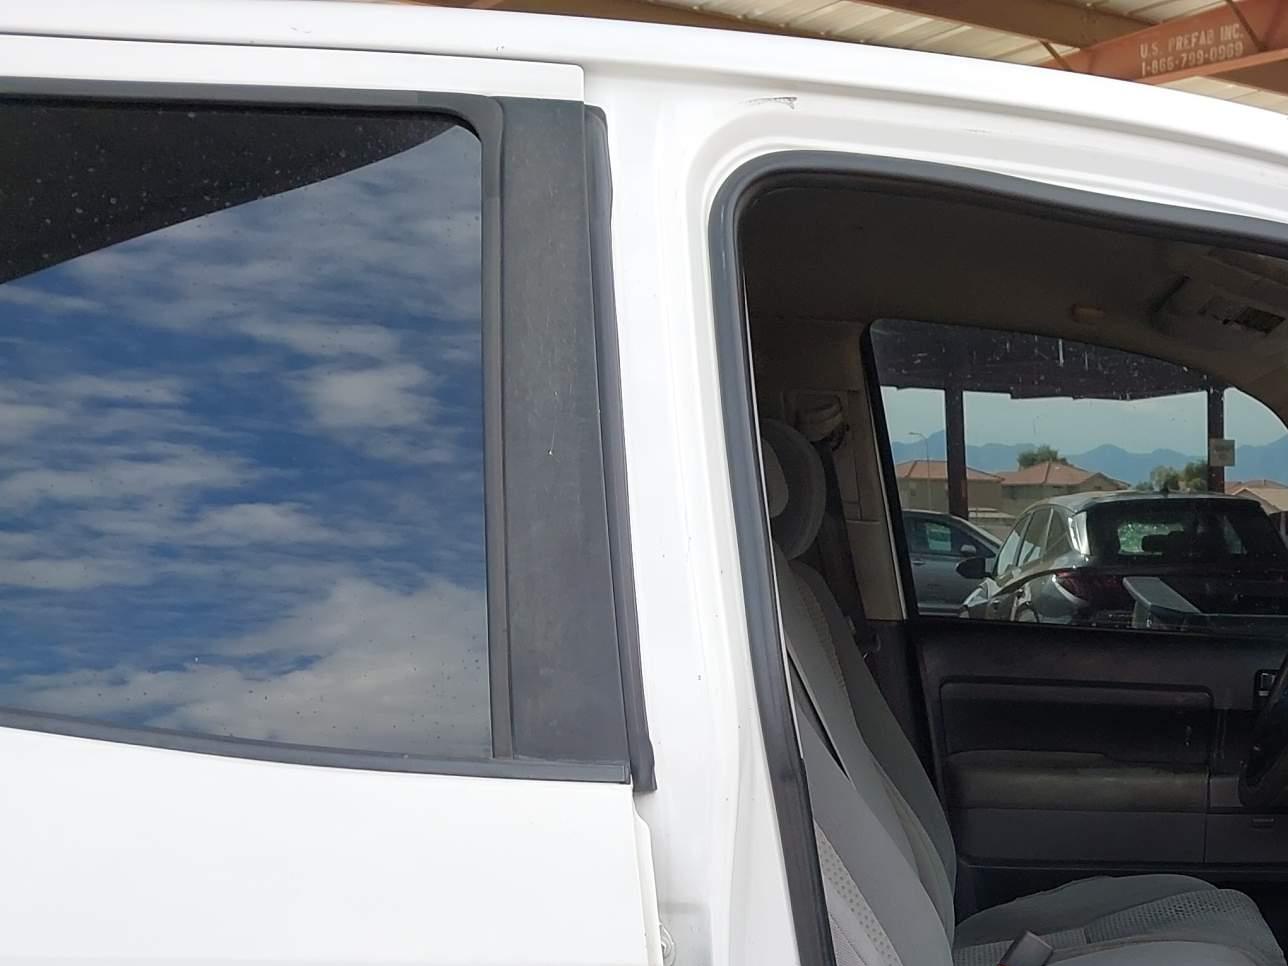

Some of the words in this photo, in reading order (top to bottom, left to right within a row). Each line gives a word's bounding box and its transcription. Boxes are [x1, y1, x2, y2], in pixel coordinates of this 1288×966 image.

[1140, 41, 1162, 58] U.S.
[1168, 28, 1215, 52] PREFAB
[1220, 23, 1244, 41] INC.
